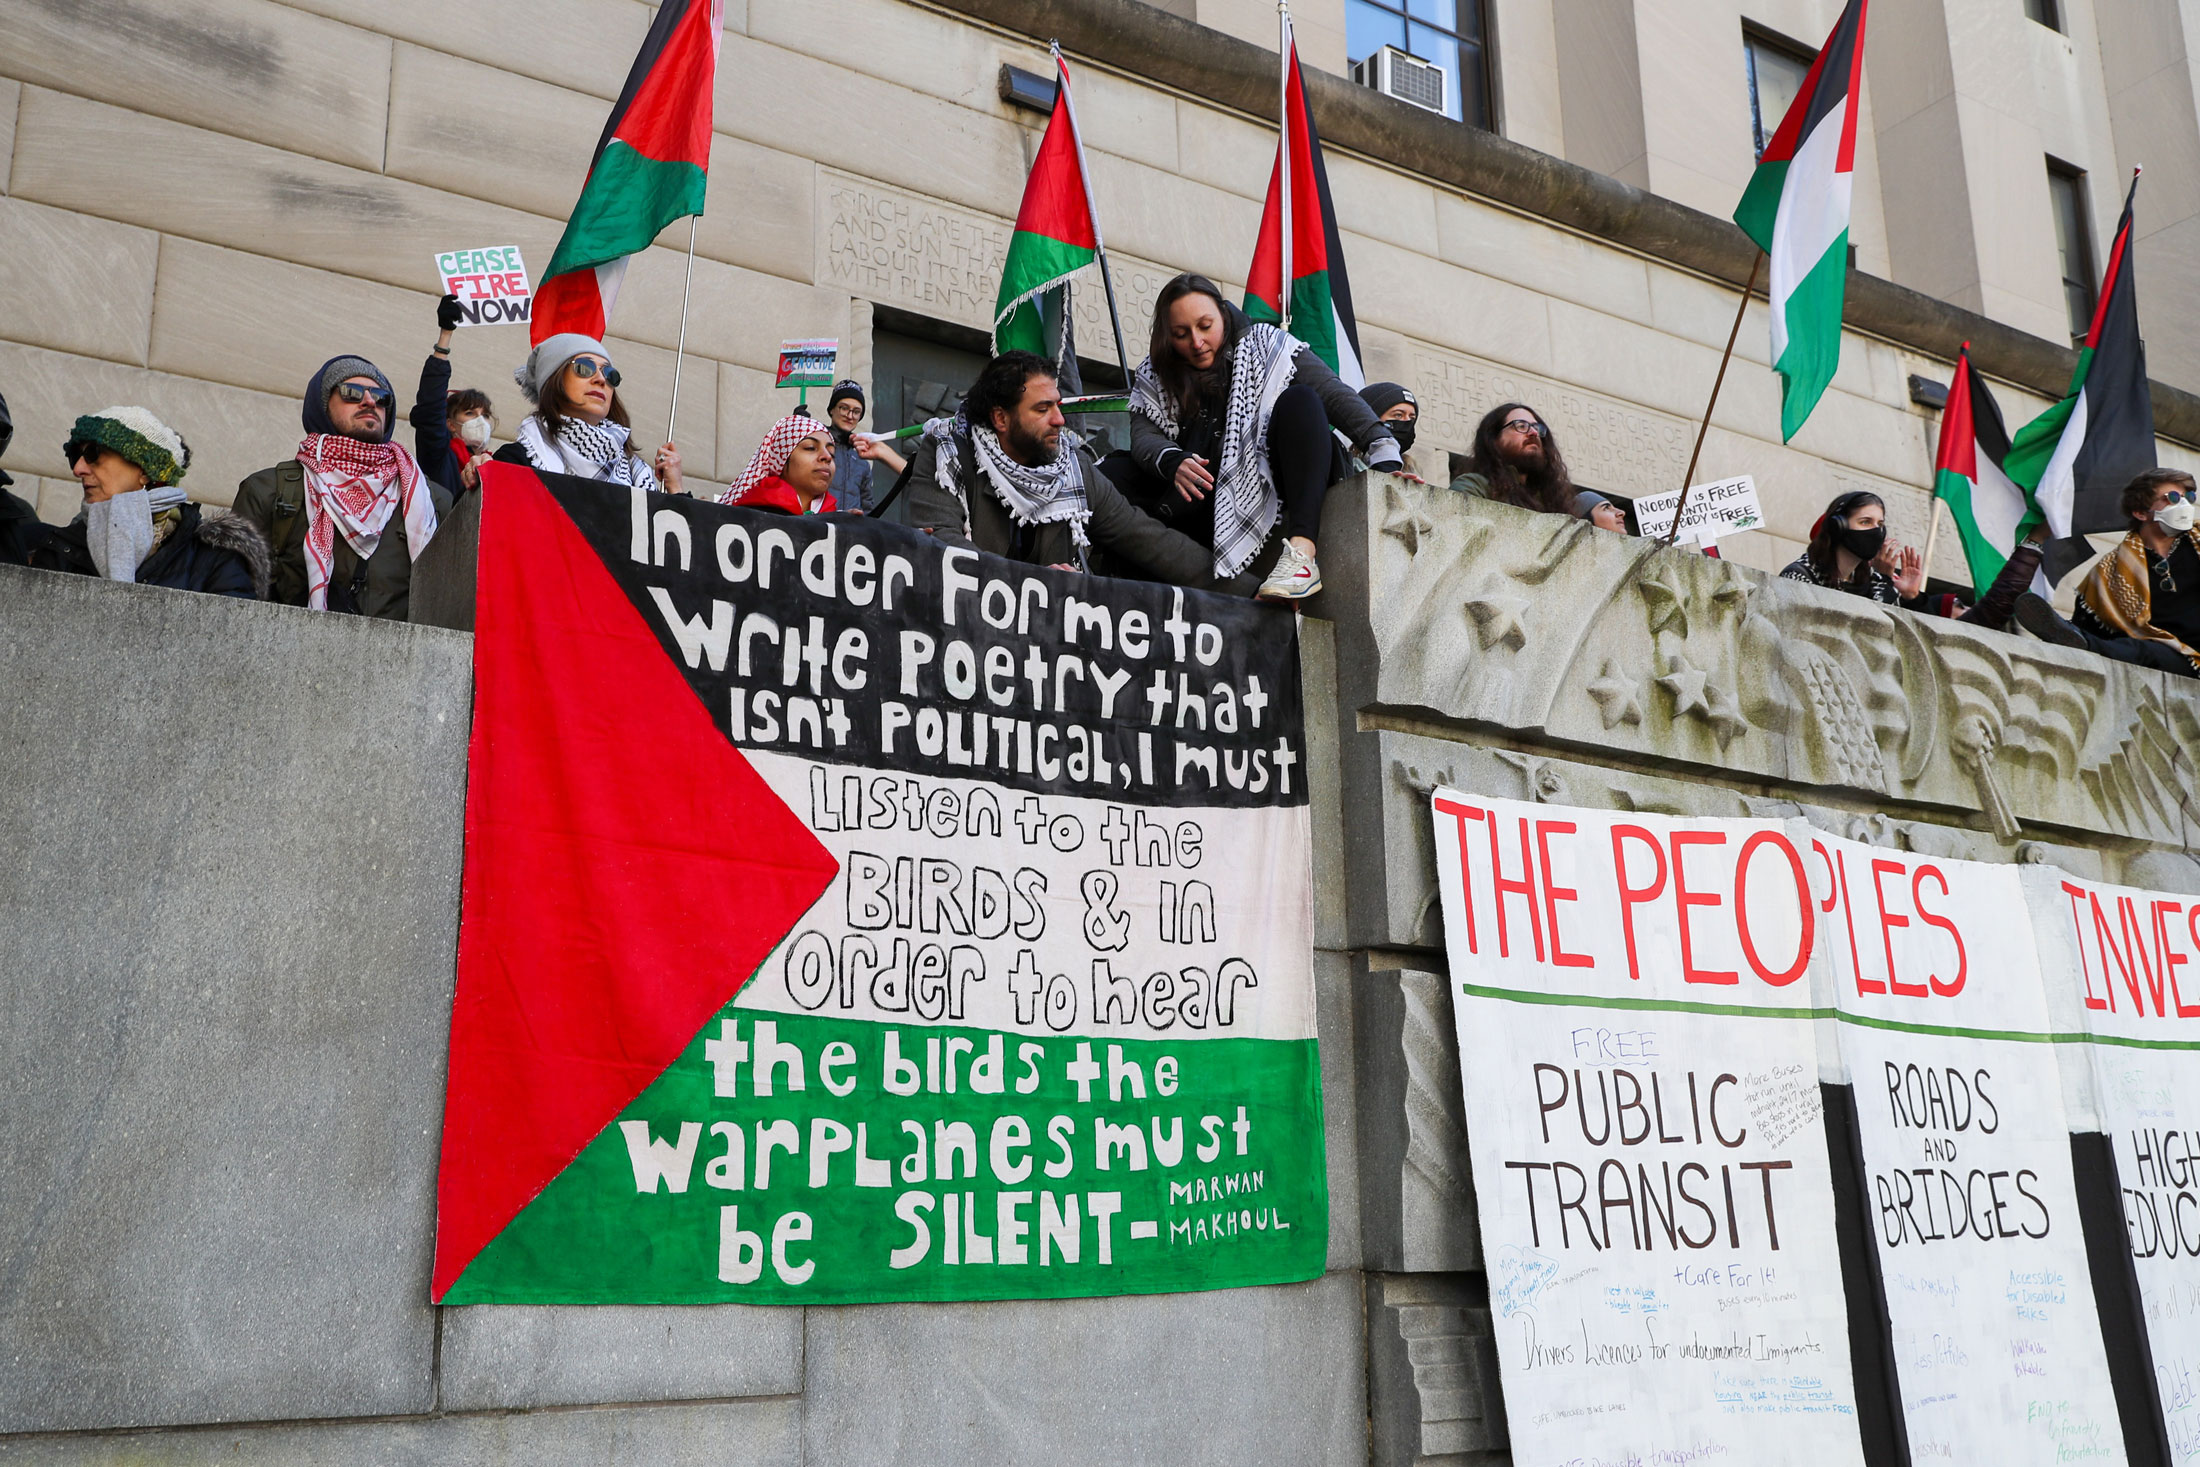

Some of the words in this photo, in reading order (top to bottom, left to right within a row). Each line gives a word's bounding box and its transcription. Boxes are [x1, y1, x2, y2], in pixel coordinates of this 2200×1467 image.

[831, 212, 887, 242] AND
[896, 228, 942, 259] SUN
[949, 243, 1006, 276] THA
[919, 212, 960, 241] ARE
[965, 224, 1003, 252] THE
[440, 248, 520, 275] CEASE
[830, 233, 920, 275] LABOUR
[928, 260, 960, 286] ITS
[447, 273, 528, 299] FIRE
[829, 256, 890, 289] WITH
[900, 276, 983, 314] PLENTY
[456, 298, 530, 324] NOW
[782, 356, 834, 372] GENOCIDE
[1415, 376, 1452, 399] MEN
[1566, 417, 1600, 440] AND
[1608, 429, 1684, 465] GUIDANCE
[1491, 376, 1582, 417] COMBINED
[1587, 403, 1656, 439] ENERGIES
[1663, 426, 1682, 443] OF
[1419, 395, 1438, 413] OF
[1578, 440, 1611, 462] MIND
[1617, 450, 1656, 475] SHAPE
[1591, 462, 1648, 491] HUMAN
[1639, 495, 1687, 515] NOBODY
[1708, 481, 1750, 502] FREE
[1681, 502, 1717, 516] UNTIL
[1719, 504, 1755, 522] FREE
[630, 487, 692, 571] In
[715, 522, 915, 611] order
[1063, 595, 1151, 660] me
[1164, 586, 1224, 666] to
[1146, 668, 1269, 734] that
[730, 686, 852, 748] Isn't
[1138, 732, 1153, 785] I
[1175, 736, 1297, 795] must
[1015, 796, 1084, 852] to
[1100, 806, 1203, 869] the
[846, 851, 1048, 941] BIRDS
[1080, 869, 1131, 952] &
[1434, 797, 1595, 968] THE
[1008, 949, 1077, 1031] to
[1092, 957, 1258, 1030] hear
[704, 1018, 857, 1098] the
[882, 1030, 1045, 1096] birds
[1066, 1041, 1179, 1103] the
[1571, 1027, 1660, 1059] FREE
[1744, 1072, 1769, 1088] More
[1772, 1064, 1803, 1079] Buses
[1760, 1088, 1776, 1098] run
[1779, 1077, 1800, 1093] until
[1533, 1063, 1746, 1148] PUBLIC
[1795, 1096, 1816, 1110] rural
[1884, 1060, 1999, 1134] ROADS
[1094, 1105, 1251, 1172] must
[1924, 1137, 1957, 1163] AND
[1169, 1170, 1264, 1207] MARWAN
[1504, 1158, 1793, 1252] TRANSIT
[1876, 1168, 2050, 1247] BRIDGES
[717, 1204, 816, 1285] be
[1169, 1207, 1289, 1246] MAKHOUL
[1728, 1264, 1752, 1288] For
[2006, 1286, 2018, 1303] for
[2022, 1288, 2066, 1305] Disabled
[2010, 1266, 2066, 1287] Accessible
[1718, 1296, 1741, 1312] Buses
[1743, 1295, 1761, 1308] every
[1769, 1291, 1797, 1304] minutes
[2016, 1305, 2049, 1321] Folks
[2166, 1284, 2180, 1321] all
[1511, 1310, 1574, 1371] Drivers
[1580, 1317, 1642, 1366] Licences
[1645, 1315, 1671, 1360] for
[1679, 1330, 1752, 1361] undocumented
[2157, 1354, 2196, 1413] Debt
[2027, 1400, 2053, 1424] END
[1649, 1438, 1728, 1467] transportation
